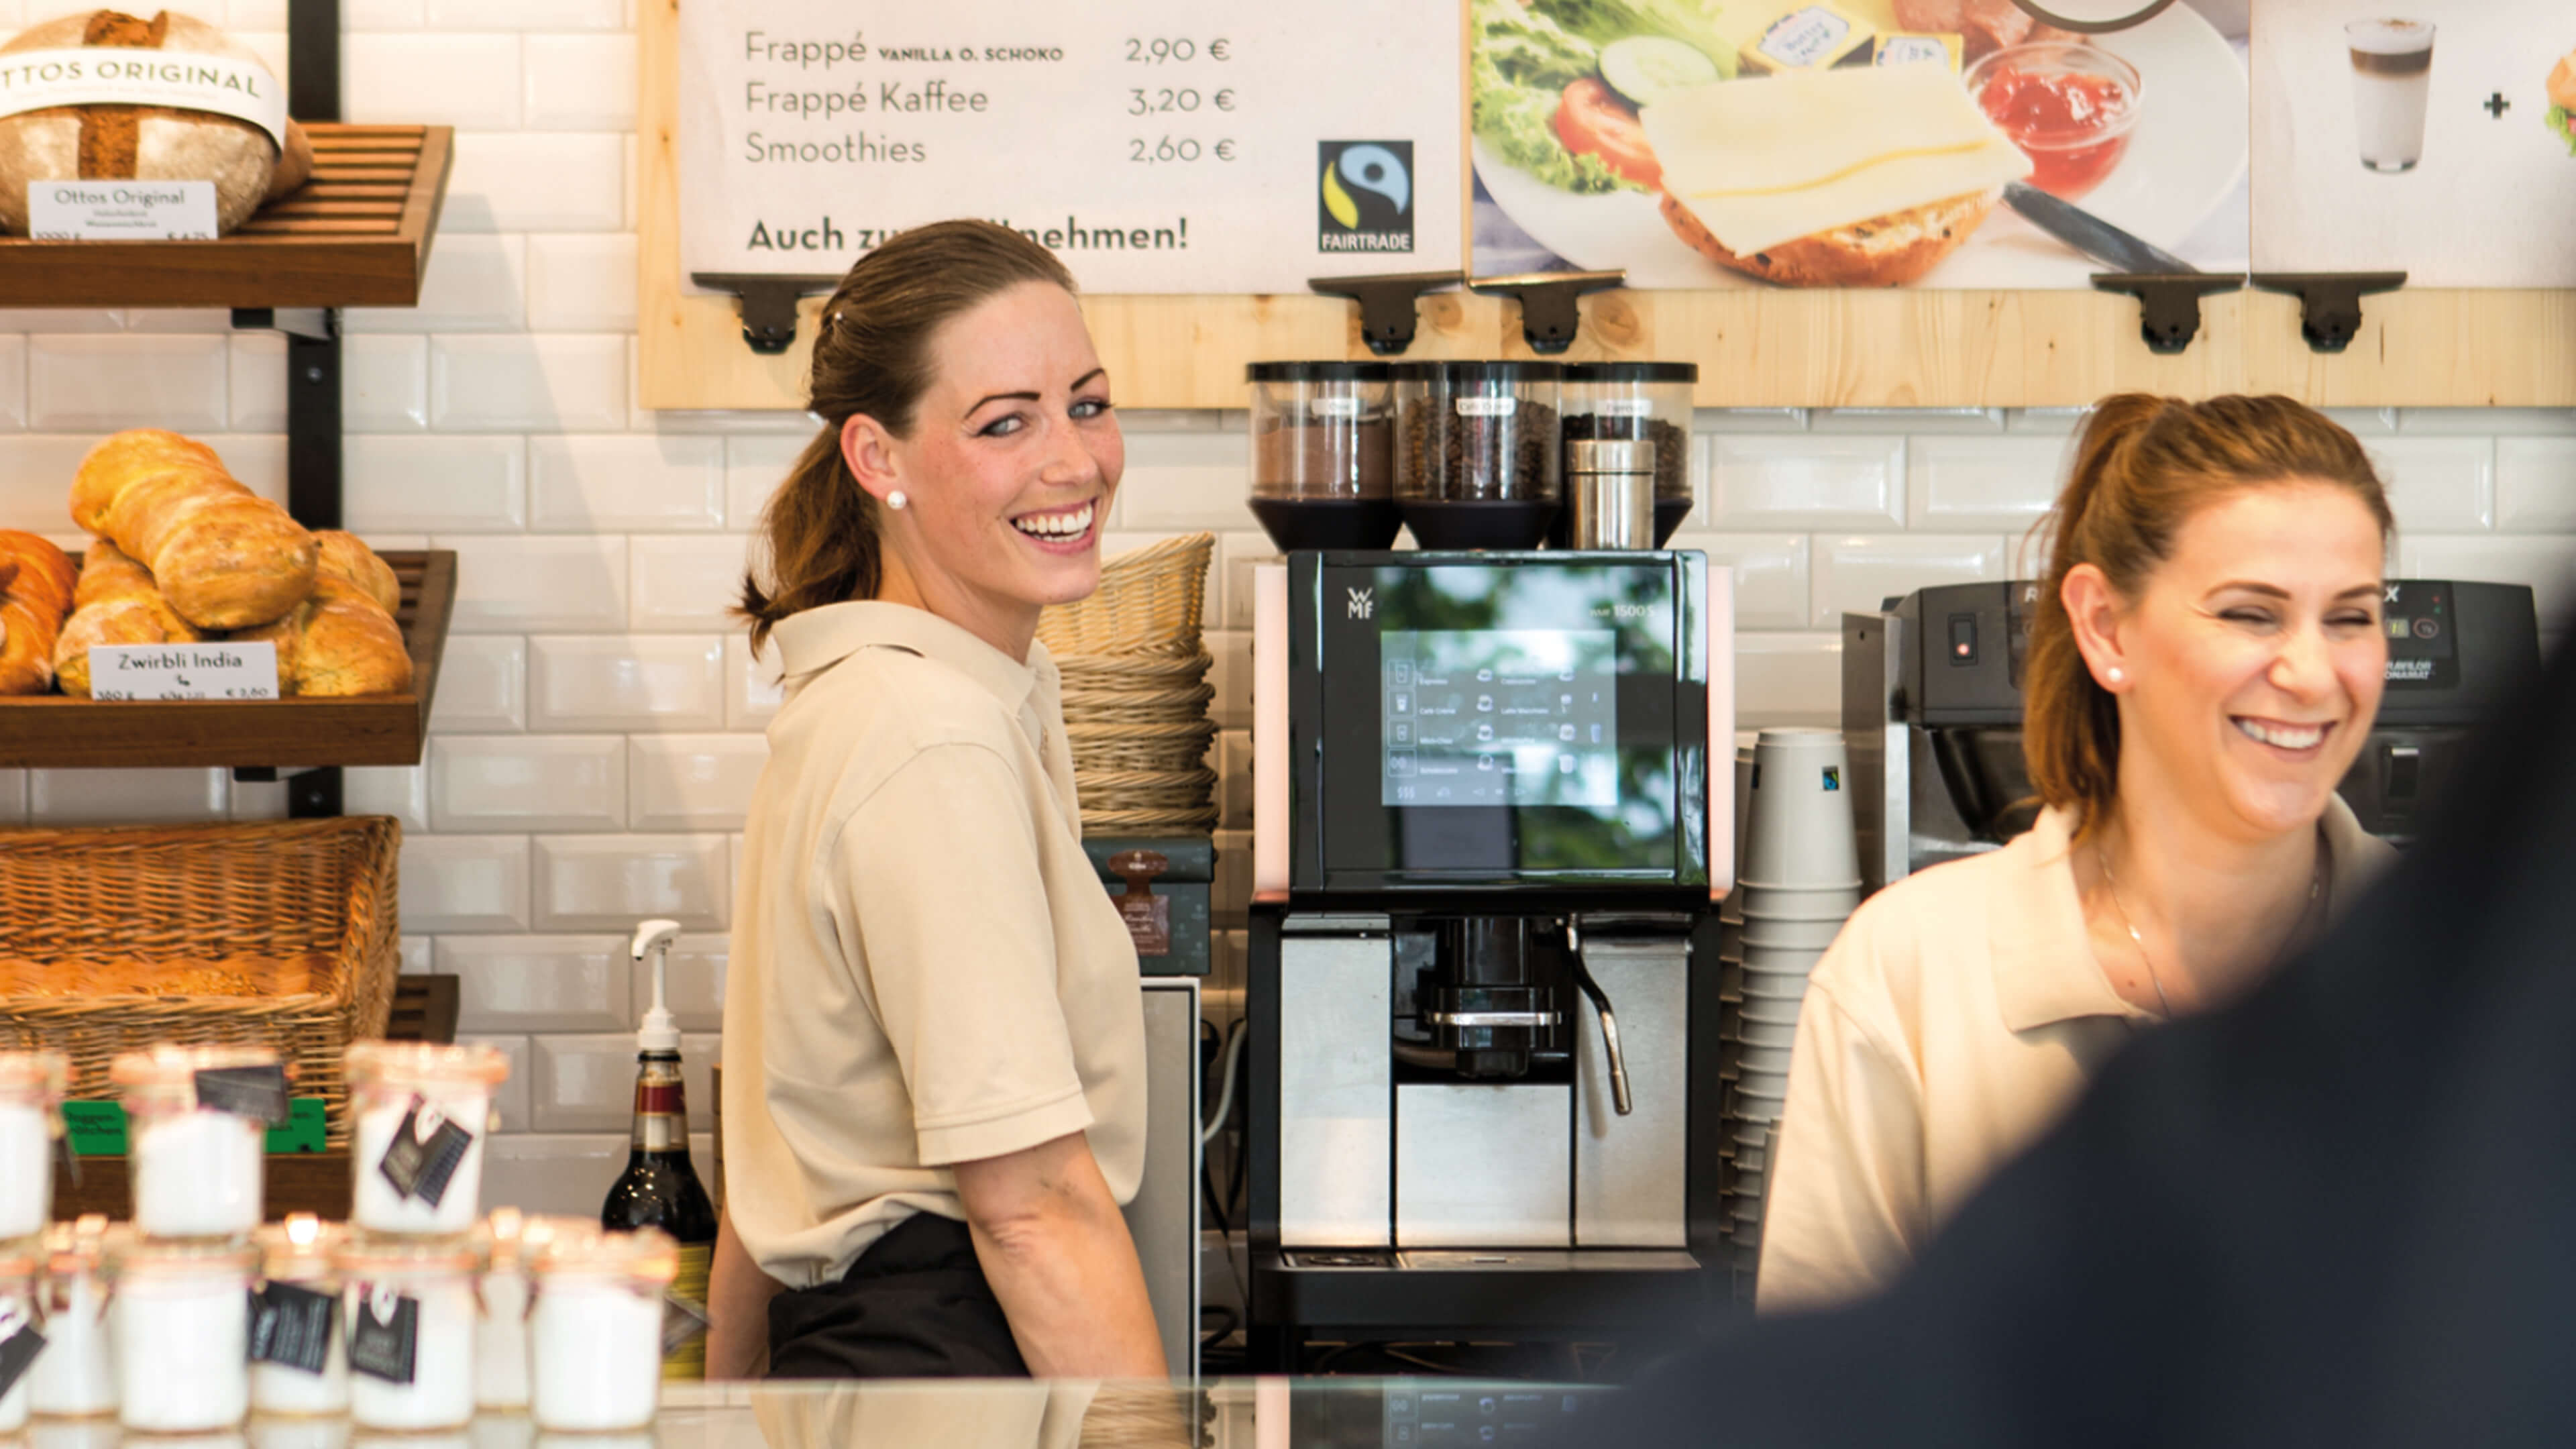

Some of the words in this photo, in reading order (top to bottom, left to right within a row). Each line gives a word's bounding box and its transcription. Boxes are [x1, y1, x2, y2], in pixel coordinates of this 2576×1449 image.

[745, 31, 867, 70] Frappé
[878, 48, 953, 61] VANILLA
[960, 48, 979, 62] O.
[985, 48, 1064, 62] SCHOKO
[1125, 38, 1195, 66] 2,90
[1208, 38, 1232, 62] €
[0, 61, 83, 90] TTOS
[96, 60, 262, 99] ORIGINAL
[745, 81, 867, 120] Frappé
[880, 79, 989, 113] Kaffee
[1128, 88, 1201, 116] 3,20
[1213, 88, 1236, 112] €
[745, 131, 926, 163] Smoothies
[1130, 134, 1201, 165] 2,60
[1214, 138, 1236, 162] €
[54, 189, 107, 205] Ottos
[113, 189, 185, 208] Original
[747, 215, 844, 251] Auch
[1322, 233, 1411, 251] FAIRTRADE
[117, 651, 186, 670] Zwirbli
[193, 651, 243, 669] India
